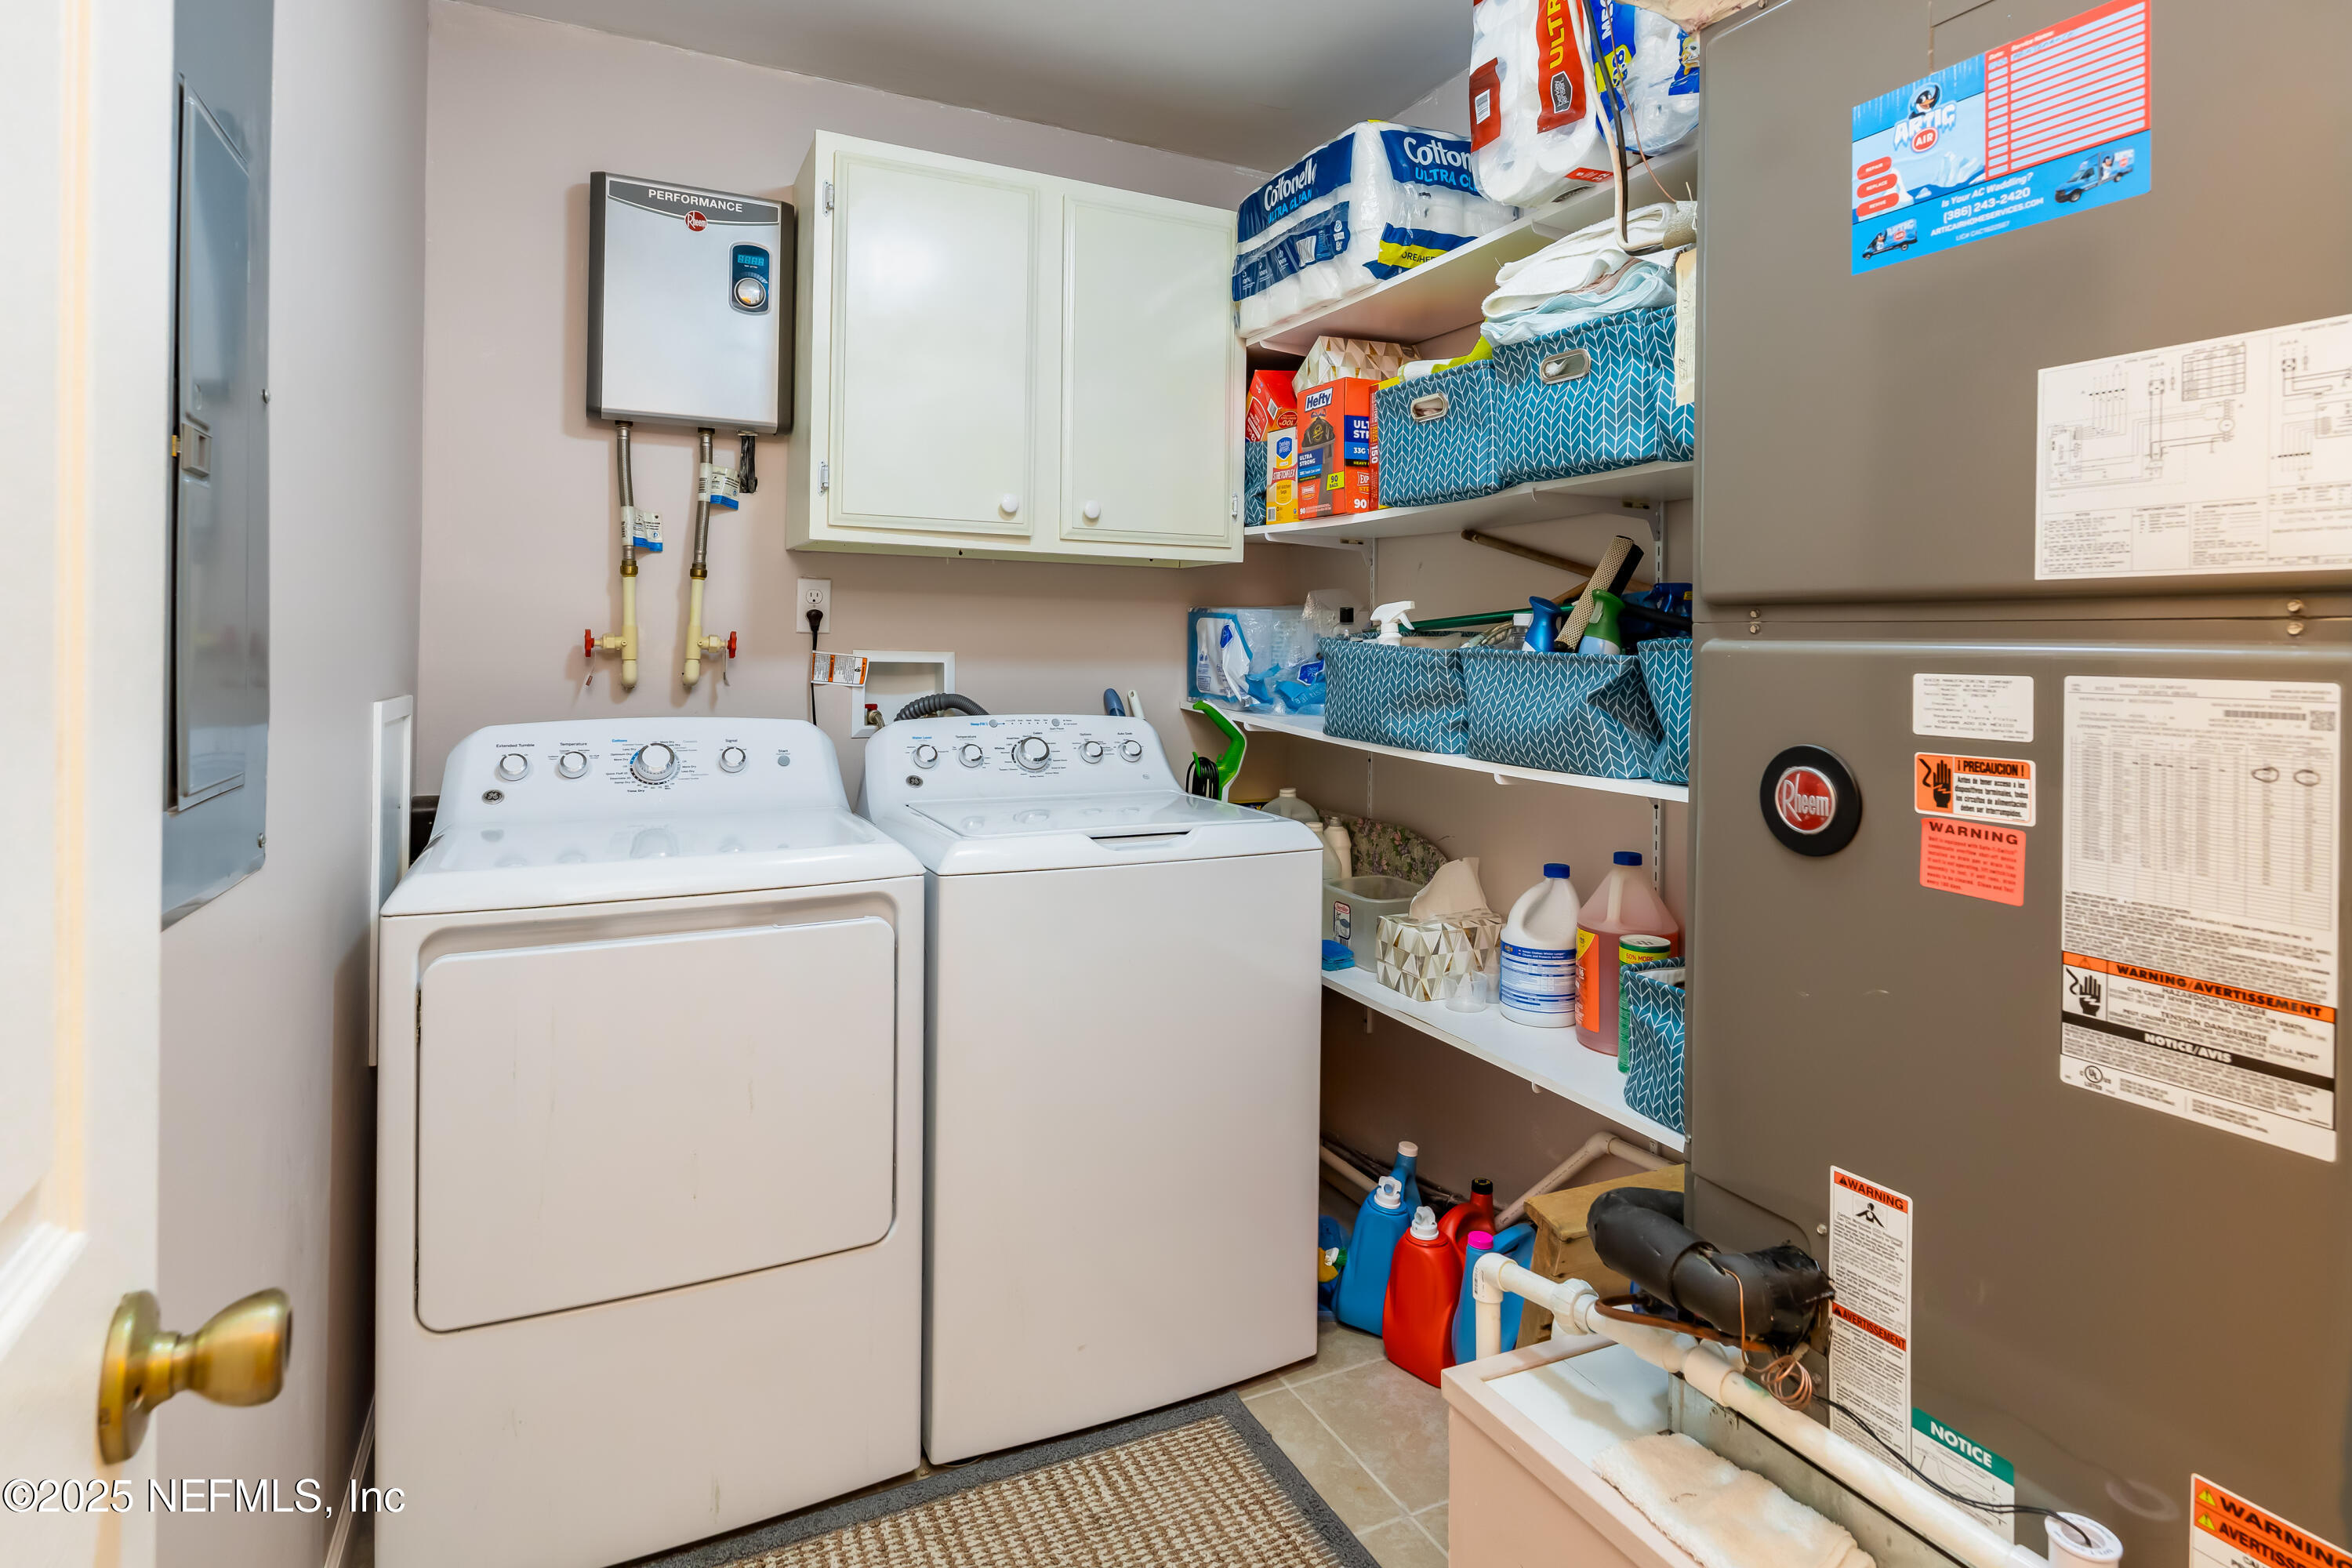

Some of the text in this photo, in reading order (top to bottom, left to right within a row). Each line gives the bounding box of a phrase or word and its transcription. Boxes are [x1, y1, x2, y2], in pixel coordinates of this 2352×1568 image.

[1894, 104, 1956, 144] ARTIC
[1915, 132, 1934, 147] AIR
[1415, 167, 1457, 186] ULTRA
[1951, 193, 1971, 205] Your
[1972, 187, 1985, 198] AC
[1987, 172, 2034, 194] Waddling?
[648, 189, 743, 212] PERFORMANCE
[1290, 188, 1312, 209] CLEAN
[1944, 187, 2031, 223] (386) 243-2420
[687, 211, 706, 229] Rheem
[1930, 198, 2045, 237] ARTICAIRHOMESERVICES.COM
[1307, 393, 1330, 408] Hefty
[1299, 459, 1316, 467] STRONG
[1354, 499, 1367, 509] 90
[1963, 760, 2018, 776] PRECAUCION
[1783, 773, 1829, 822] Rheem
[1929, 822, 2018, 845] WARNING
[2162, 988, 2266, 1015] HAZARDOUS VOLTAGE
[2161, 1011, 2267, 1042] TENSION DANGEREUSE
[2144, 1033, 2233, 1064] NOTICE/AVIS
[1848, 1178, 1903, 1210] WARNING
[1843, 1310, 1905, 1349] AVERTISSEMENT
[1930, 1421, 1992, 1468] NOTICE
